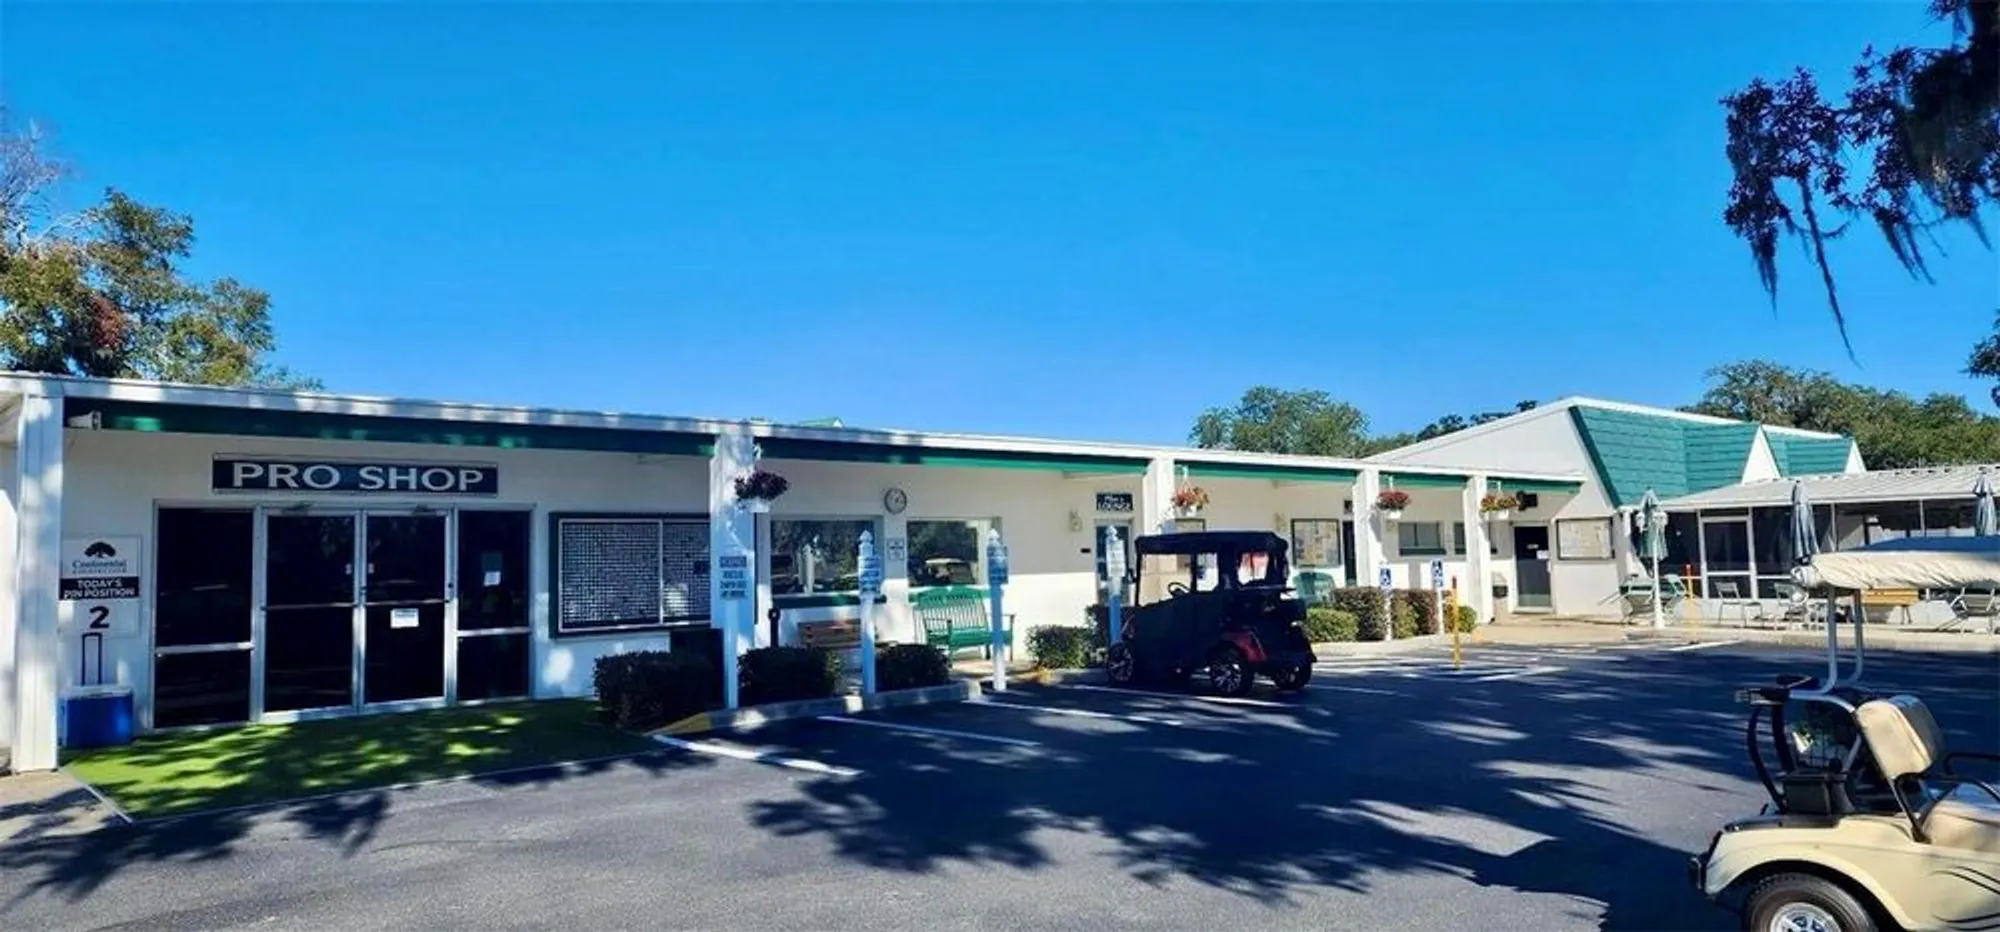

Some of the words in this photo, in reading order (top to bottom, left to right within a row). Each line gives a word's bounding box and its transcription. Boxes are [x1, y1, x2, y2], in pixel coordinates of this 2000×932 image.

[232, 462, 341, 489] PRO
[359, 466, 483, 491] SHOP
[77, 578, 122, 588] TODAY'S
[64, 588, 83, 600] PIN
[84, 587, 136, 598] POSITION
[90, 606, 109, 629] 2
